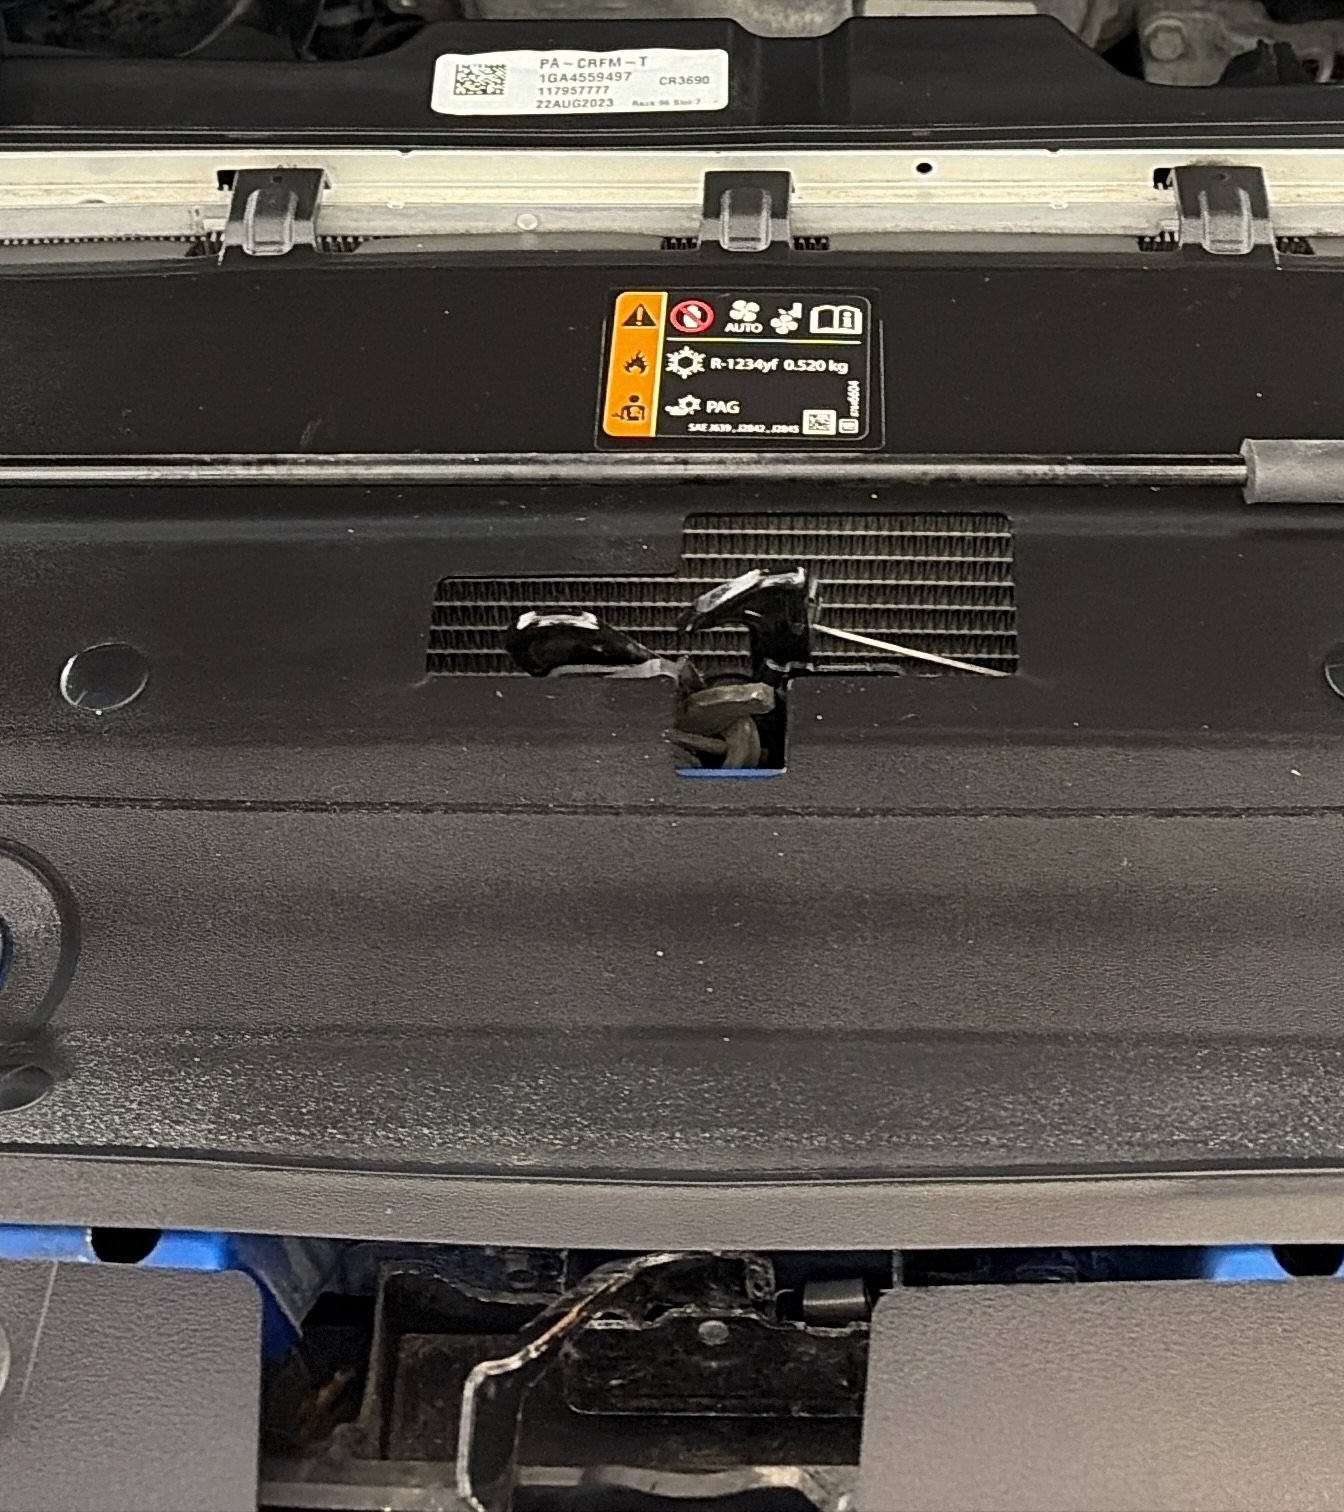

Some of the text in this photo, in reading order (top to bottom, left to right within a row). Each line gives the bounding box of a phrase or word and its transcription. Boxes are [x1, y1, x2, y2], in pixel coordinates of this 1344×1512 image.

[539, 71, 632, 83] 1GA4559497
[659, 75, 710, 86] CR3690
[537, 85, 610, 96] 117957777
[535, 97, 615, 109] 22AUG2023
[724, 322, 763, 333] AUTO
[710, 357, 849, 375] R-1234yf 0.520 kg
[705, 400, 741, 414] PAG
